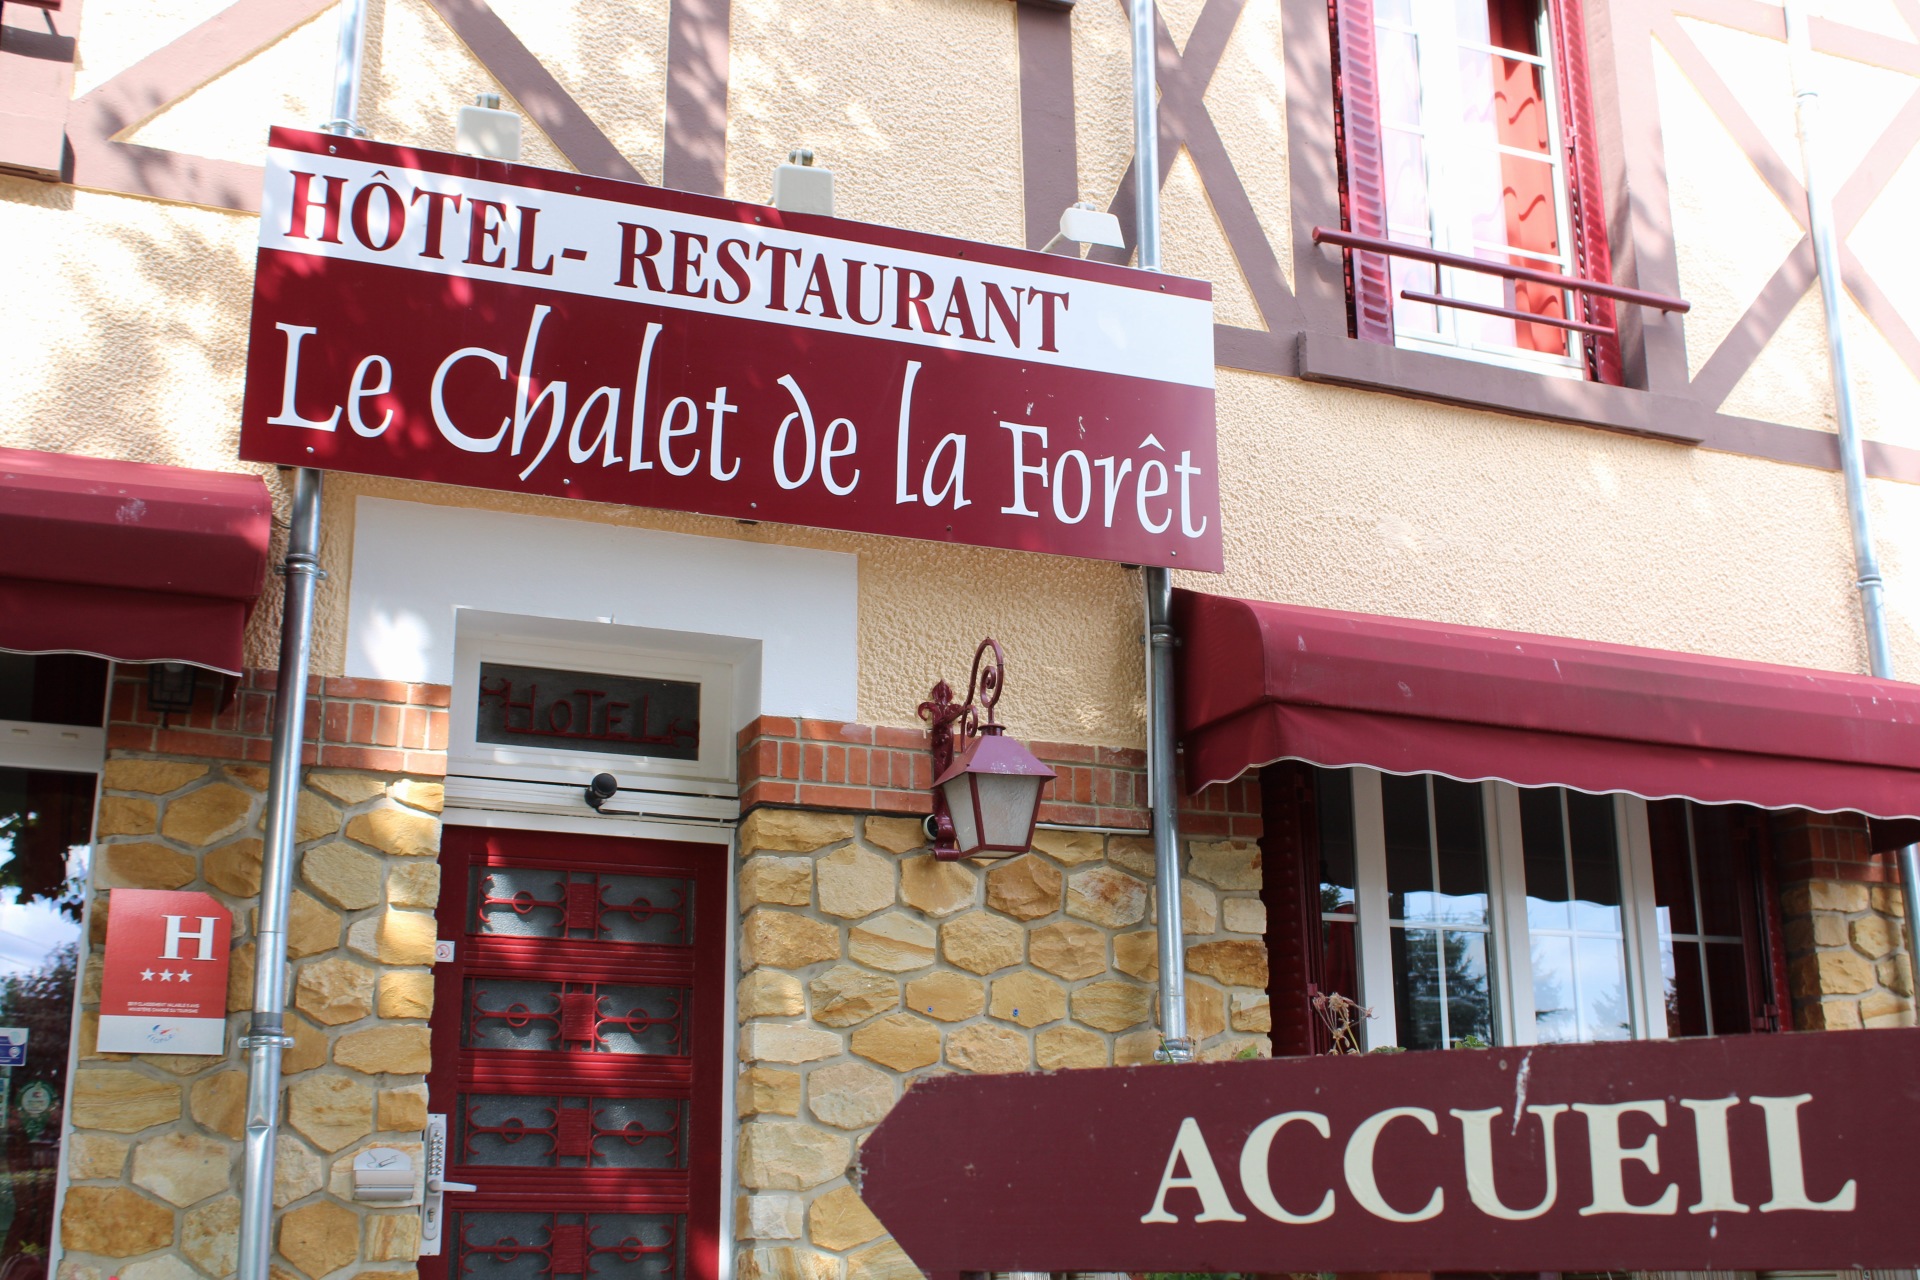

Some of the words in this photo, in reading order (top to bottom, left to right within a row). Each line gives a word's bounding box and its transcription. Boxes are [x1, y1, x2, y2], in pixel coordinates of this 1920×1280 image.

[613, 221, 1070, 353] RESTAURANT
[266, 321, 394, 438] Le
[429, 303, 740, 483] Chalet
[772, 374, 861, 497] de
[895, 360, 972, 511] la
[999, 420, 1208, 539] Forêt
[157, 914, 221, 961] H
[1140, 1092, 1858, 1225] ACCUEIL
